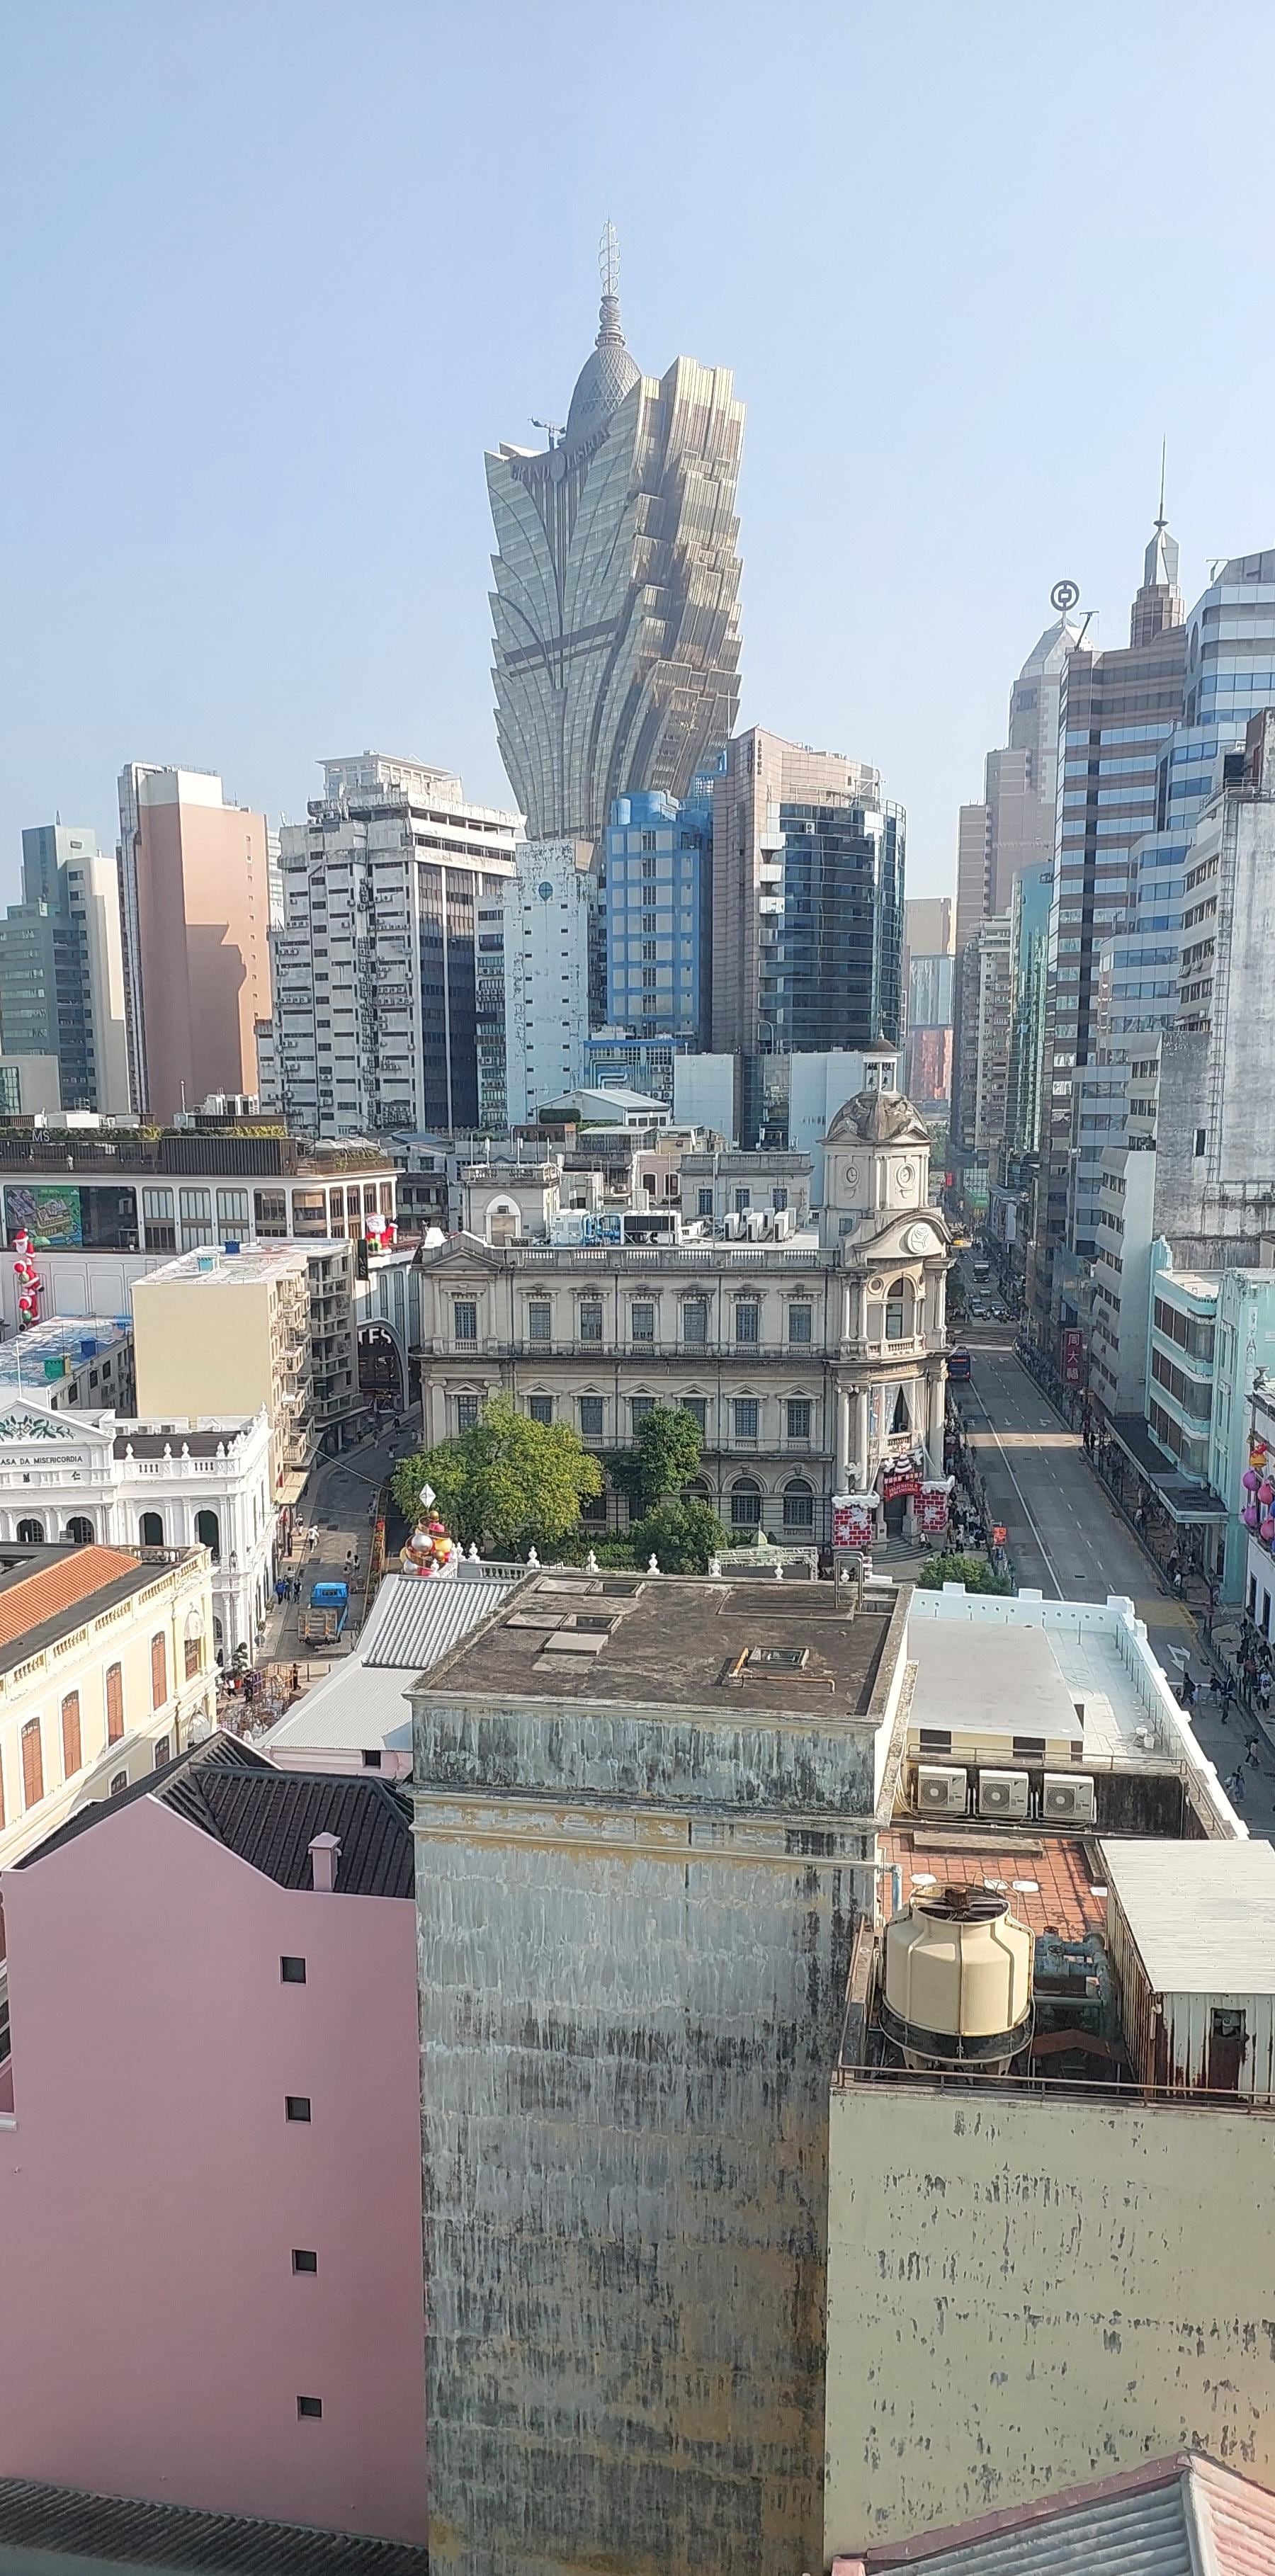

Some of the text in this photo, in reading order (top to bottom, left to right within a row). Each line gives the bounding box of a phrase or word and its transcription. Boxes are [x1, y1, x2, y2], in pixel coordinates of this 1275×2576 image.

[1066, 1334, 1080, 1380] 周大福
[33, 1456, 83, 1464] MISERICORDIA
